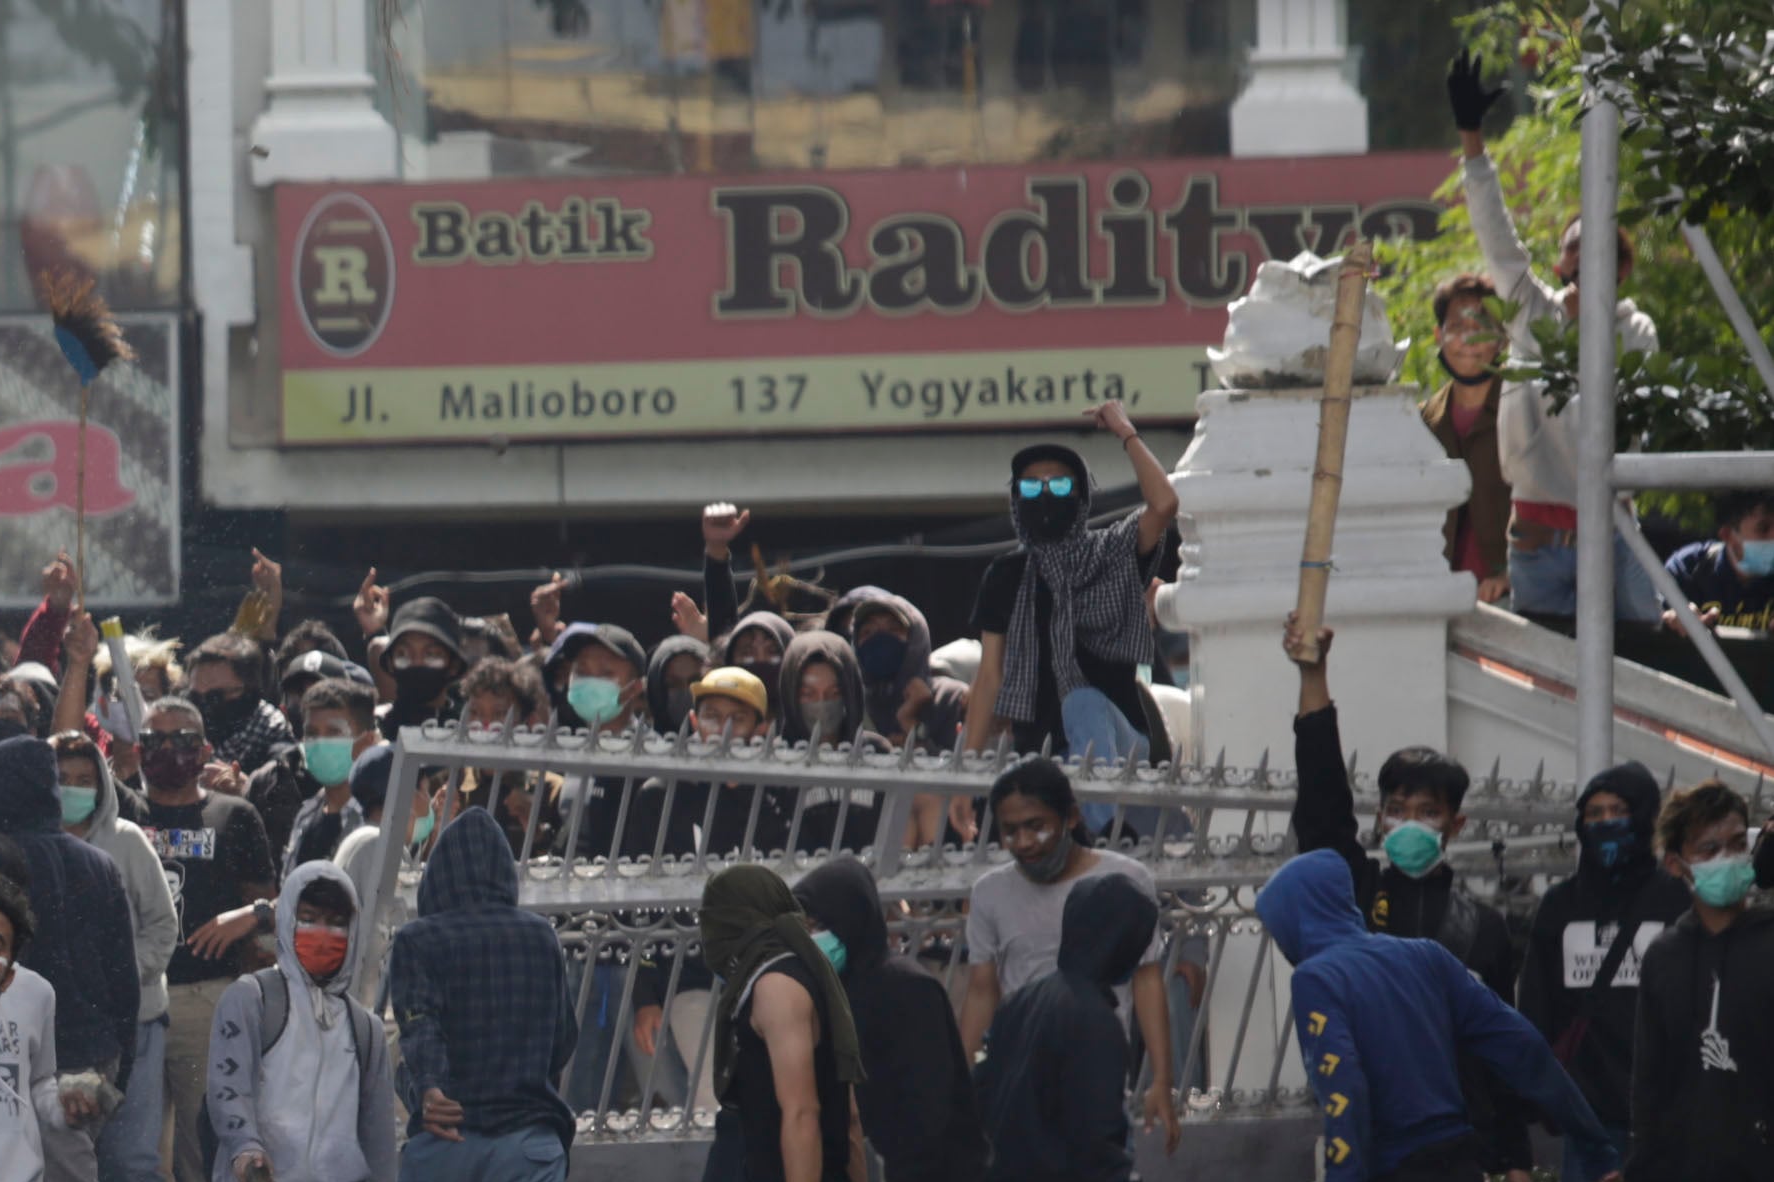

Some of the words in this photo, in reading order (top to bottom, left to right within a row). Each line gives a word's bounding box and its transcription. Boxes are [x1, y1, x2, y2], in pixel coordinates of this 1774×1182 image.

[410, 196, 652, 264] Batik
[314, 248, 376, 302] R
[340, 386, 390, 423] Jl.
[439, 378, 677, 423] Malioboro
[730, 374, 809, 414] 137
[860, 367, 1142, 418] Yogyakarta,
